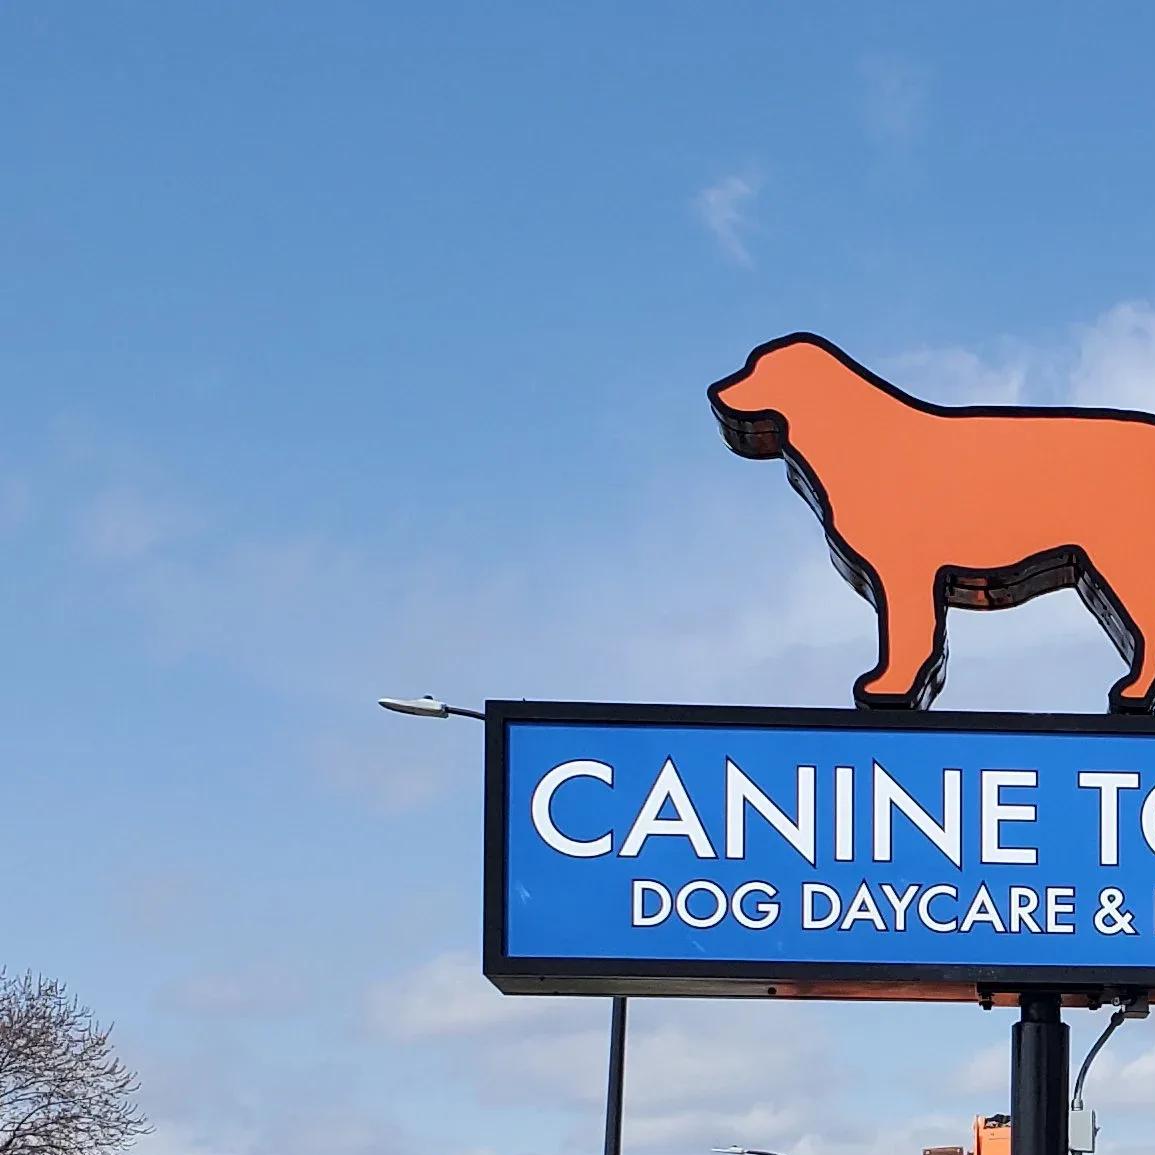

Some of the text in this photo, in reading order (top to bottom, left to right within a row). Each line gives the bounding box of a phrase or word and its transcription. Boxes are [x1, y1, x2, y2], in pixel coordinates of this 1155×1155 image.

[531, 757, 1038, 867] CANINE
[632, 879, 779, 930] DOG
[803, 882, 1074, 934] DAYCARE
[1094, 888, 1136, 935] &
